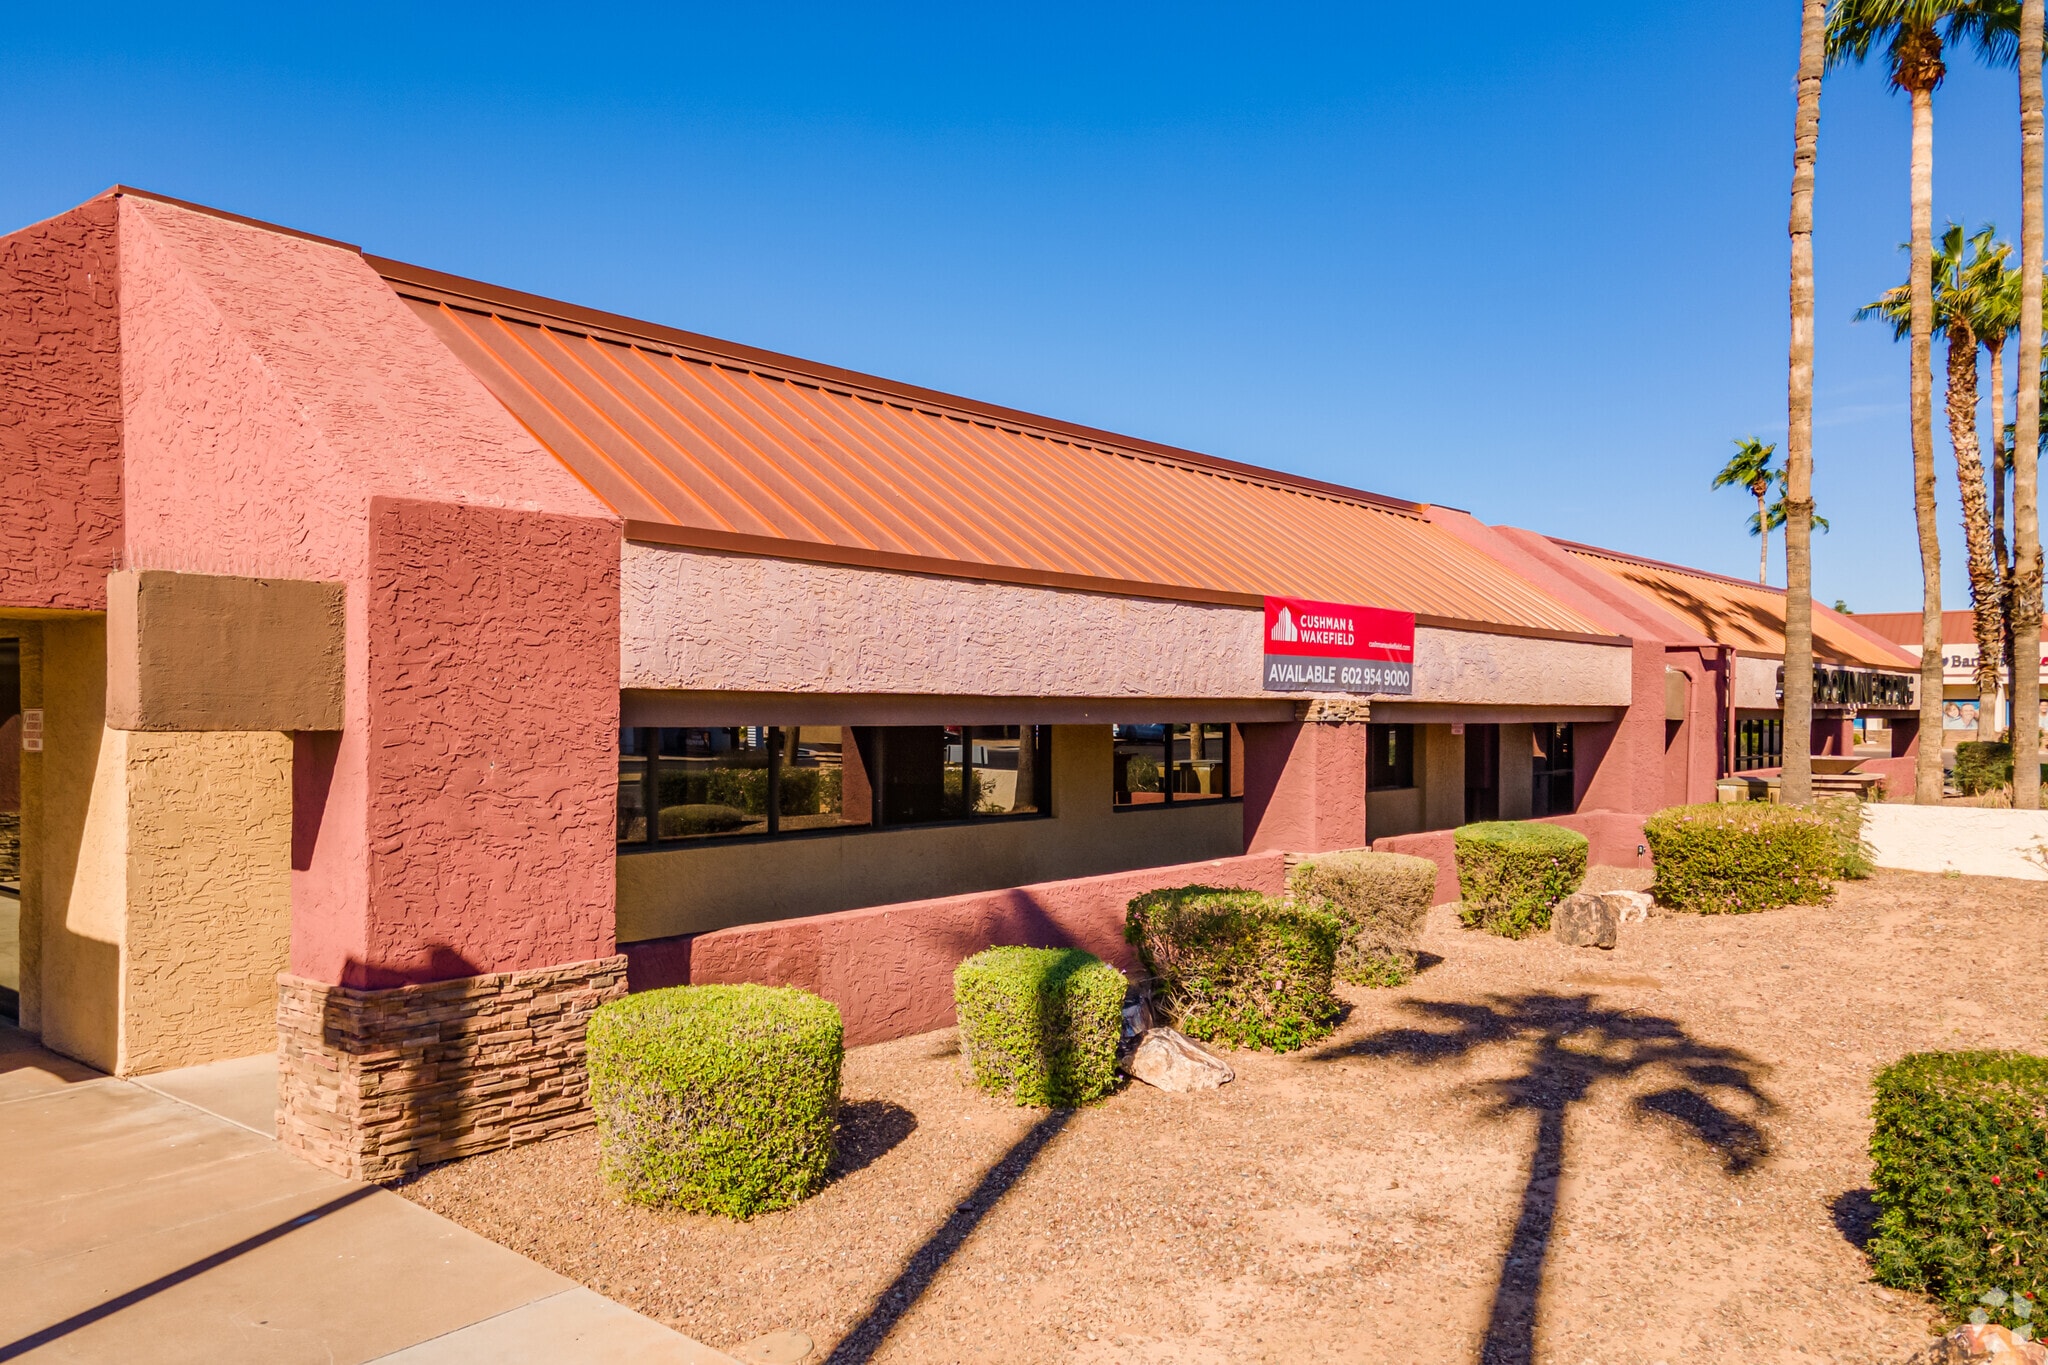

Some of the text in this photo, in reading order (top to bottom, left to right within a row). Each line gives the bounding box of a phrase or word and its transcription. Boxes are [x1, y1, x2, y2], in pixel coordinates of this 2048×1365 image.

[1300, 614, 1355, 632] CUSHMAN &
[1300, 629, 1355, 646] WAKEFIELD
[1268, 663, 1410, 687] AVAILABLE 602 954 9000
